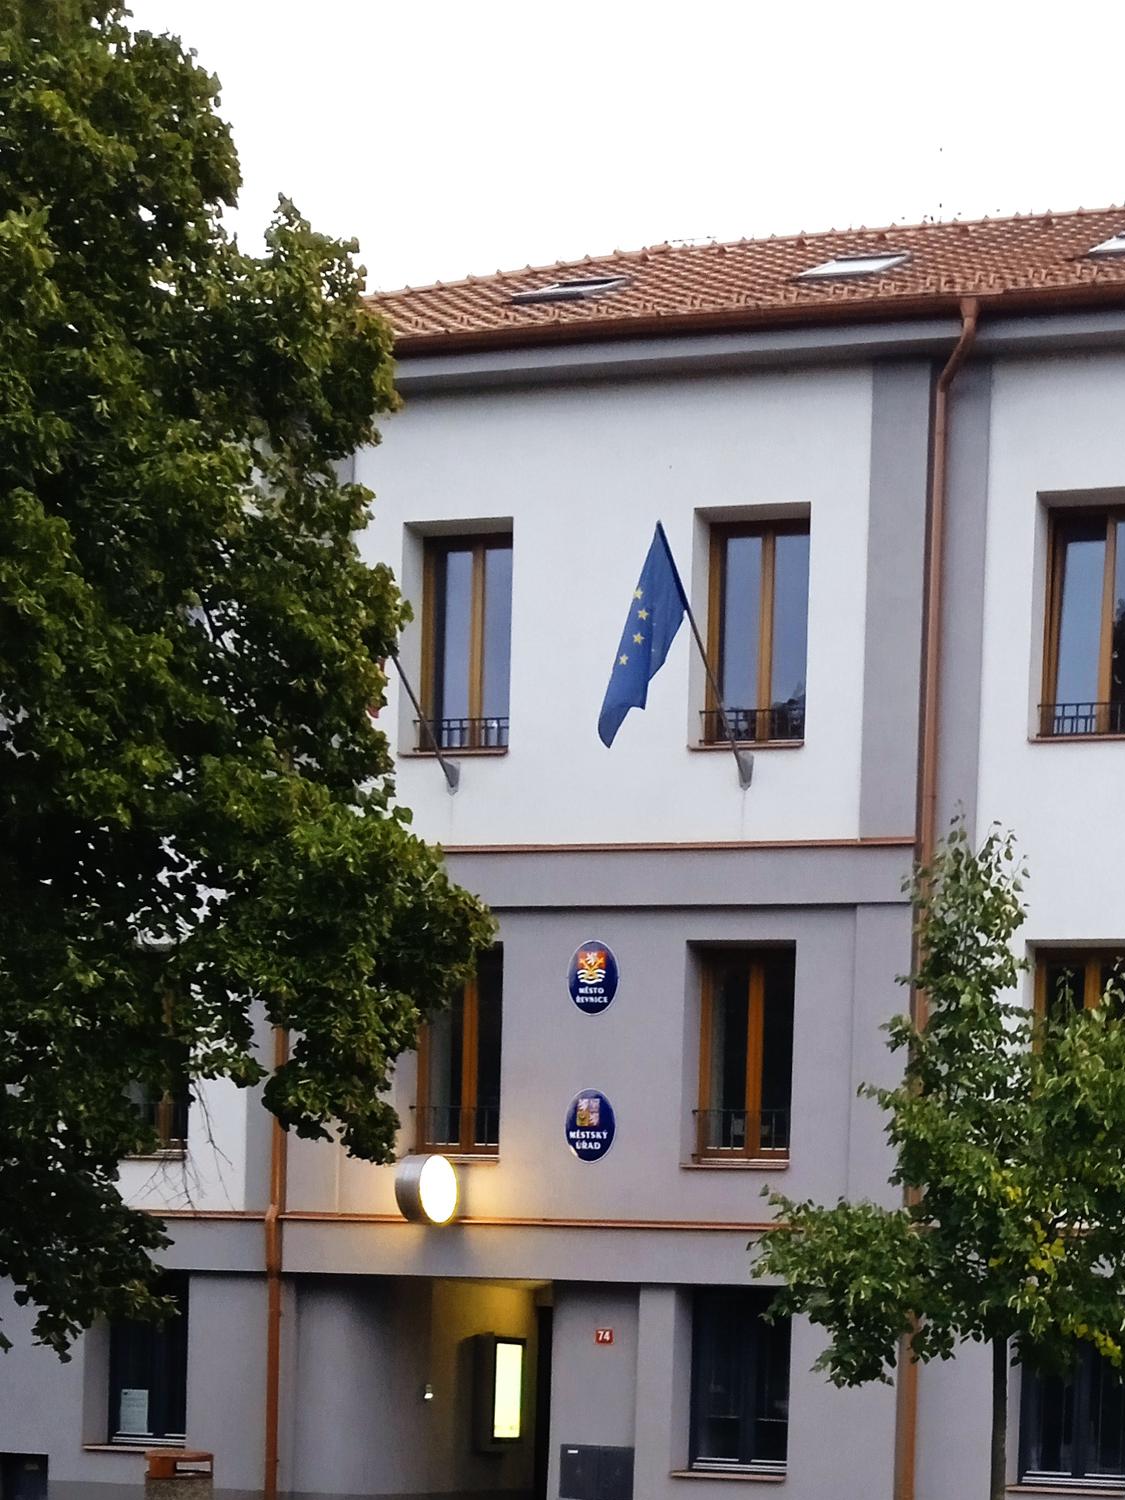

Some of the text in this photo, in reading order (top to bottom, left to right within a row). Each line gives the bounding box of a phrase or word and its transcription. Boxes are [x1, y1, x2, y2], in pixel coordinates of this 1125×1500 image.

[578, 985, 605, 994] MĚSTO
[569, 1129, 608, 1139] MĚSTSKÝ
[575, 1140, 601, 1150] ÚŘAD
[598, 1330, 610, 1341] 74
